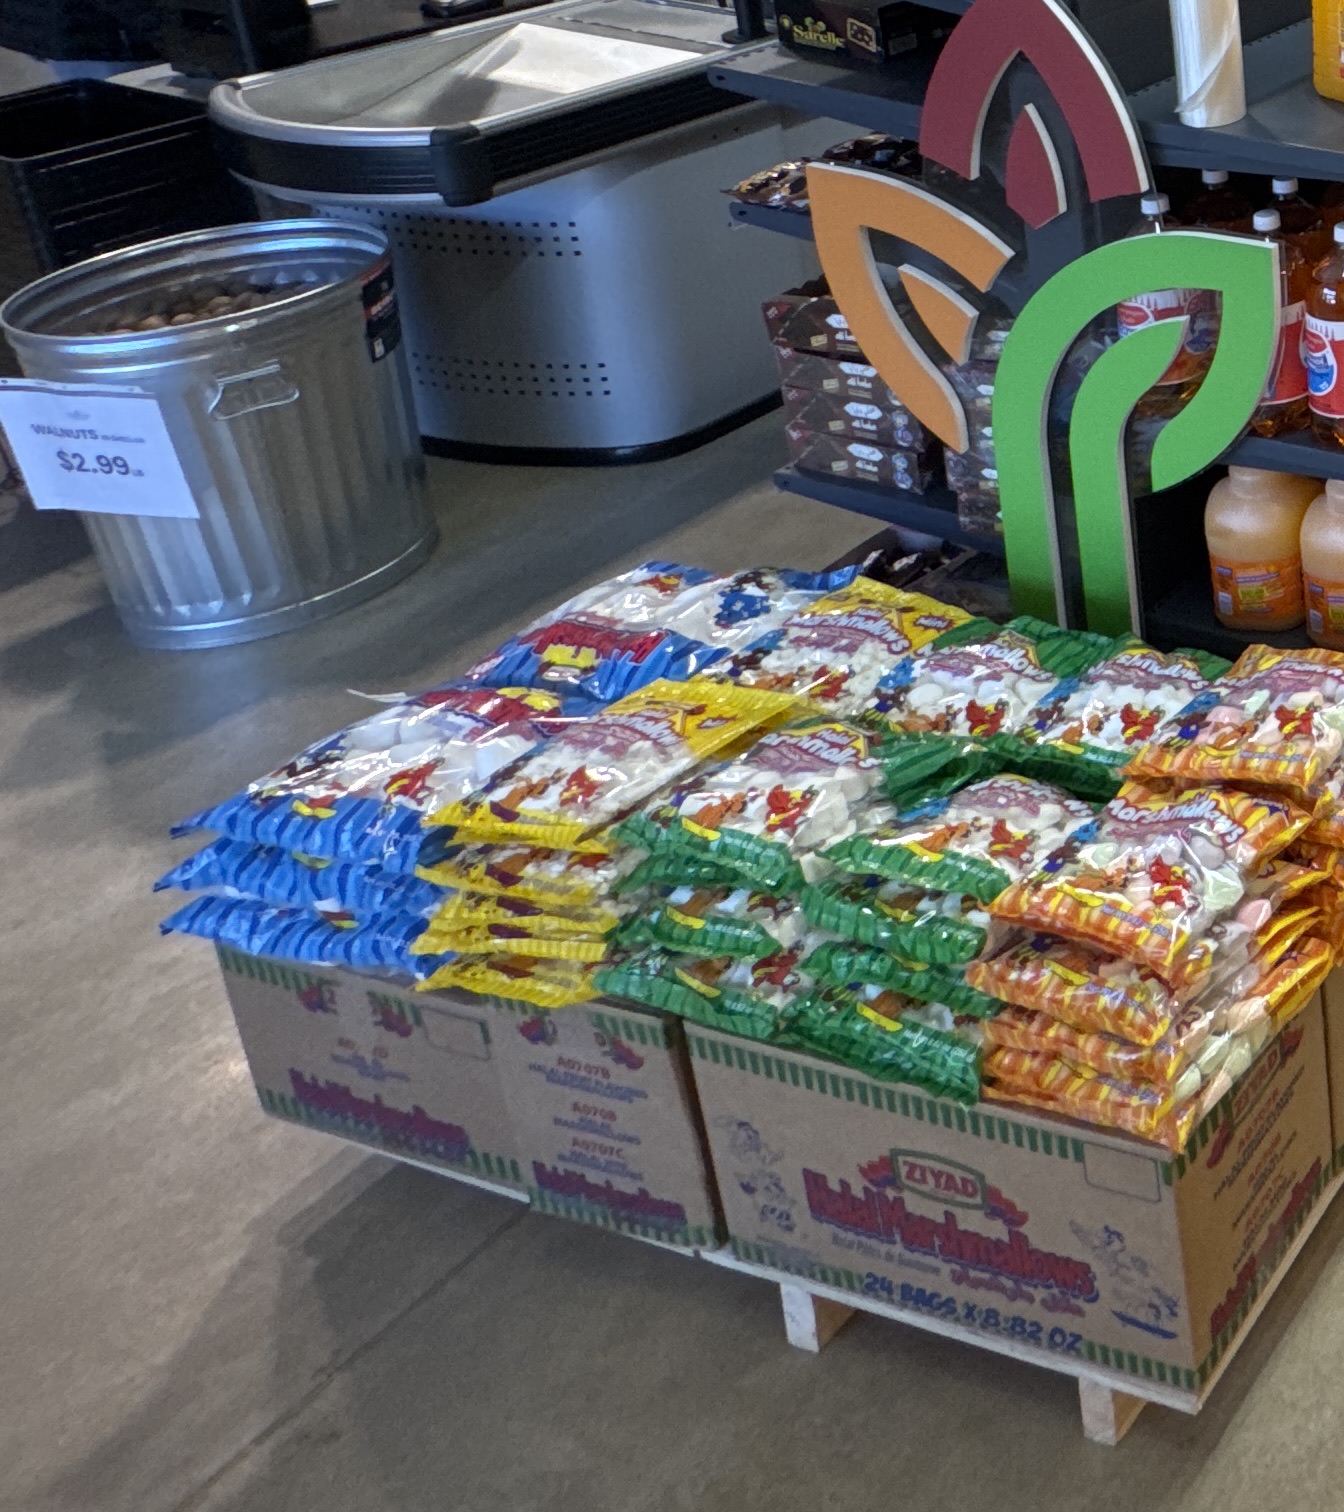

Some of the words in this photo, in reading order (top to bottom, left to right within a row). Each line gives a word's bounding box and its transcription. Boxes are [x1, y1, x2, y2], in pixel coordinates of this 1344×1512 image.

[30, 423, 99, 441] WALNUTS
[56, 449, 131, 477] $2.99
[902, 1159, 979, 1199] ZIYAD
[864, 1271, 895, 1296] 24
[900, 1282, 957, 1317] BAGS
[963, 1302, 978, 1324] X
[1046, 1325, 1085, 1353] OZ
